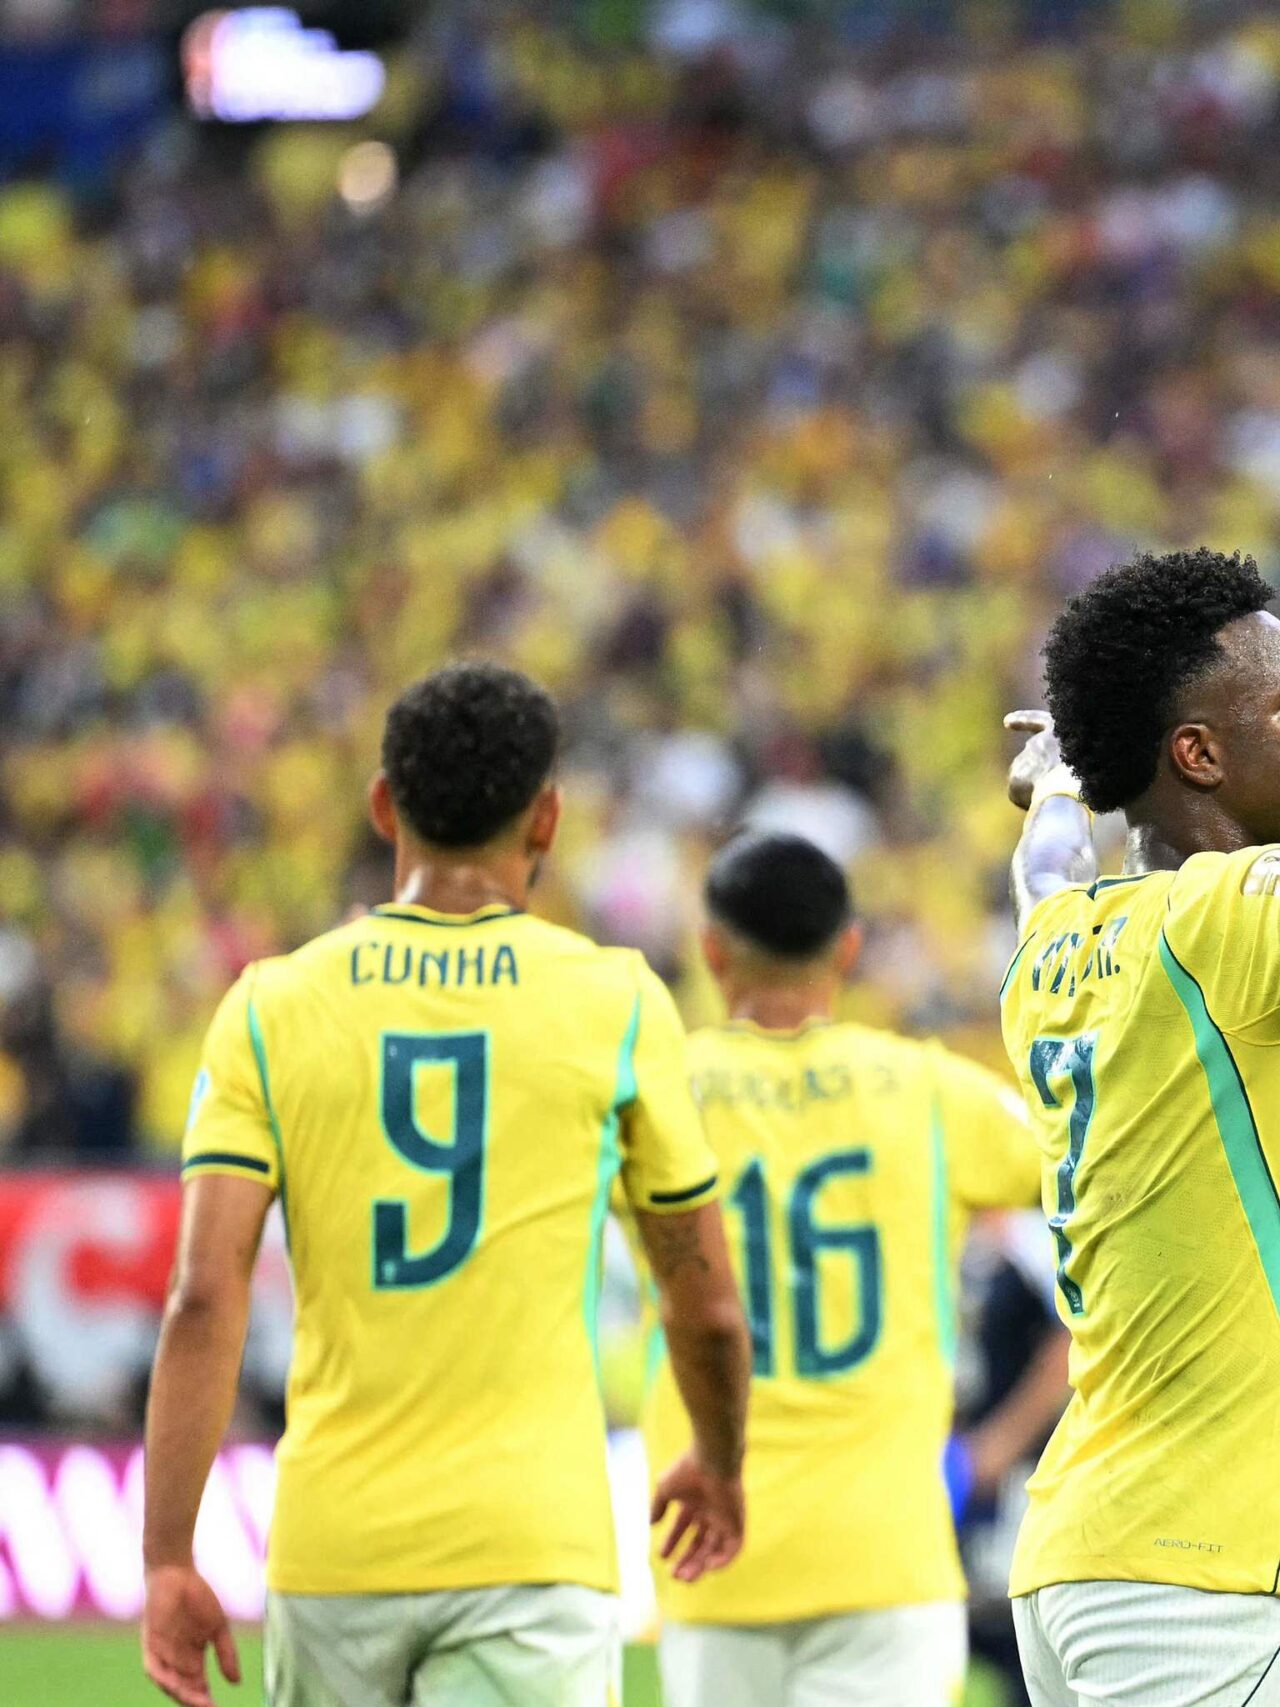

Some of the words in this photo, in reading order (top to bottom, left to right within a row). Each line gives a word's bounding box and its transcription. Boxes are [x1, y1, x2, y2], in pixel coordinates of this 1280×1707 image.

[350, 941, 518, 988] CUNHA
[372, 1030, 491, 1291] 9
[727, 1146, 883, 1382] 16
[1029, 1031, 1100, 1317] 7
